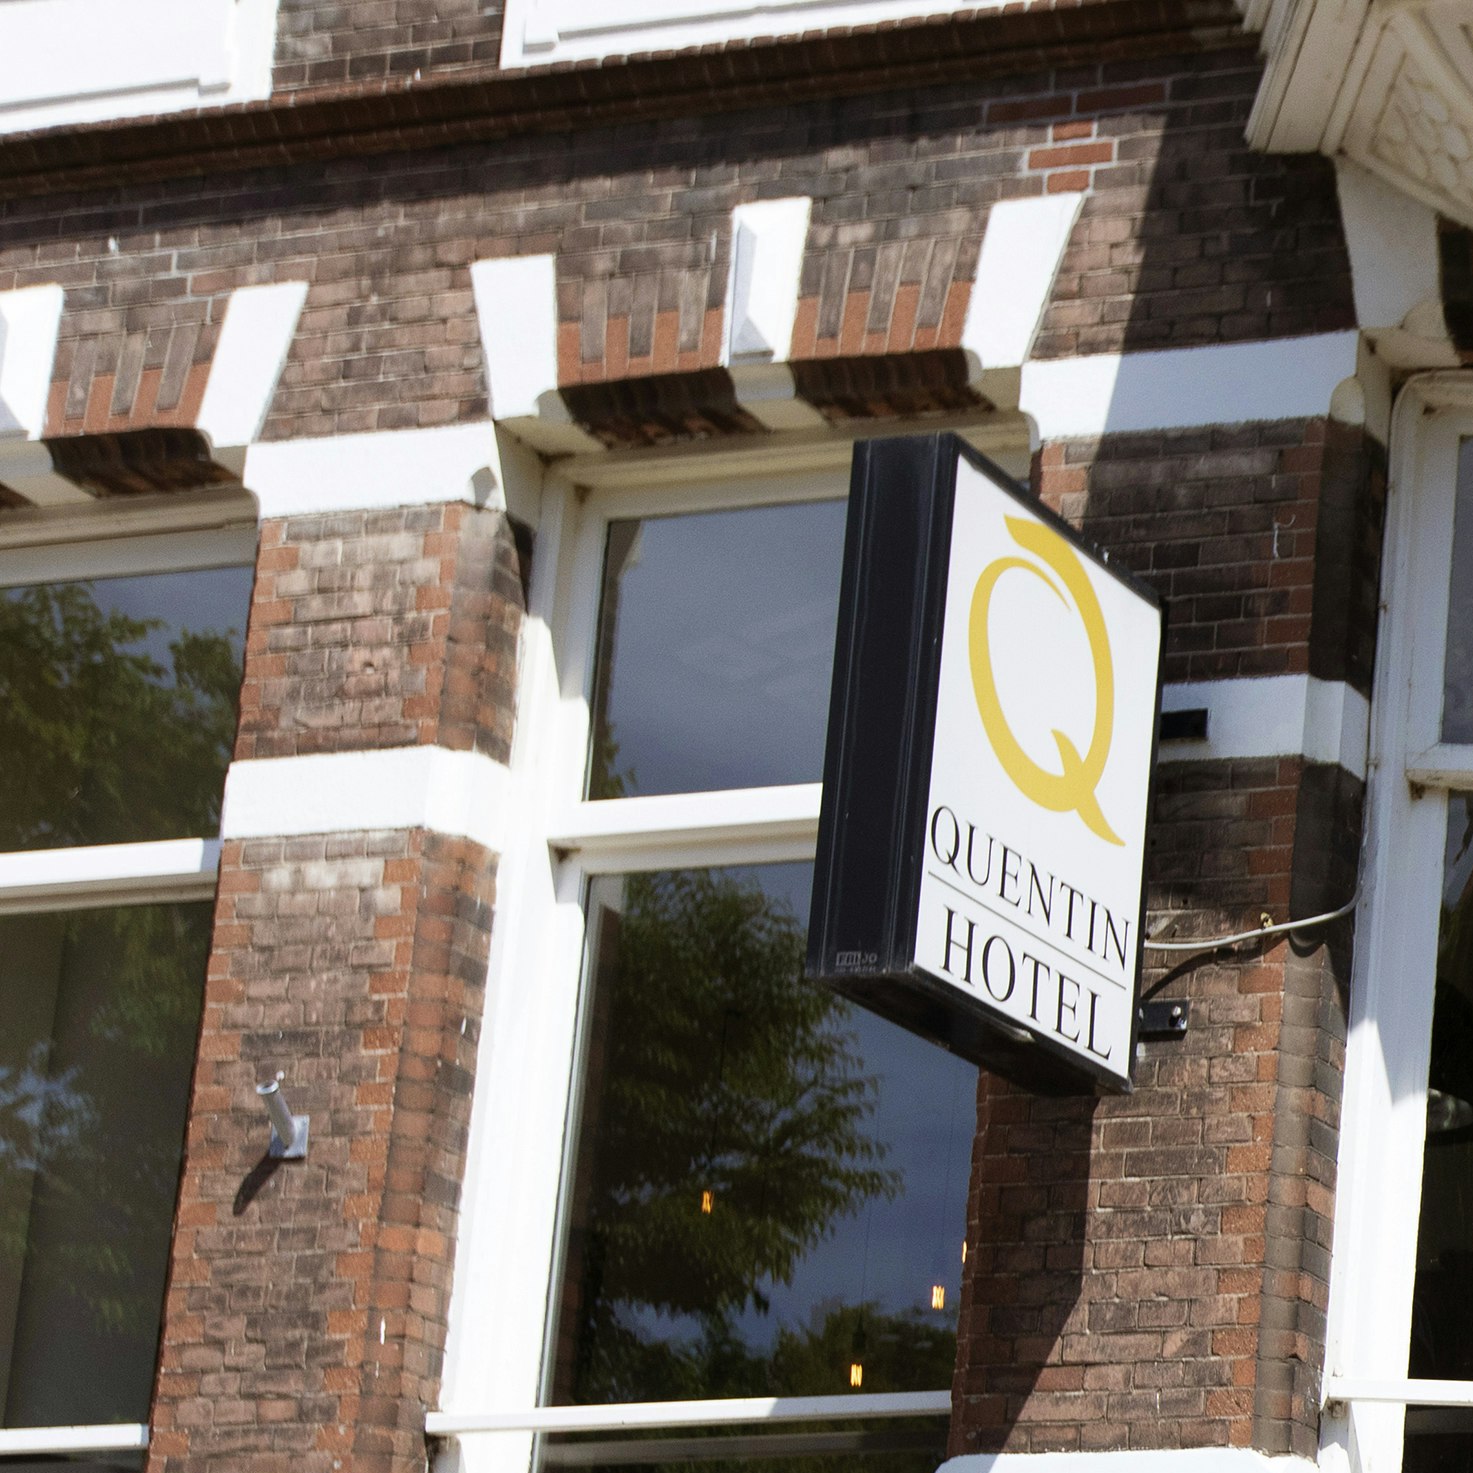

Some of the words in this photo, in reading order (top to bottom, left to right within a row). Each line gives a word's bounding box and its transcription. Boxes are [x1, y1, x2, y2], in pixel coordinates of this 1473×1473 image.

[968, 513, 1126, 847] Q
[930, 805, 1132, 972] QUENTIN
[939, 903, 1113, 1061] HOTEL
